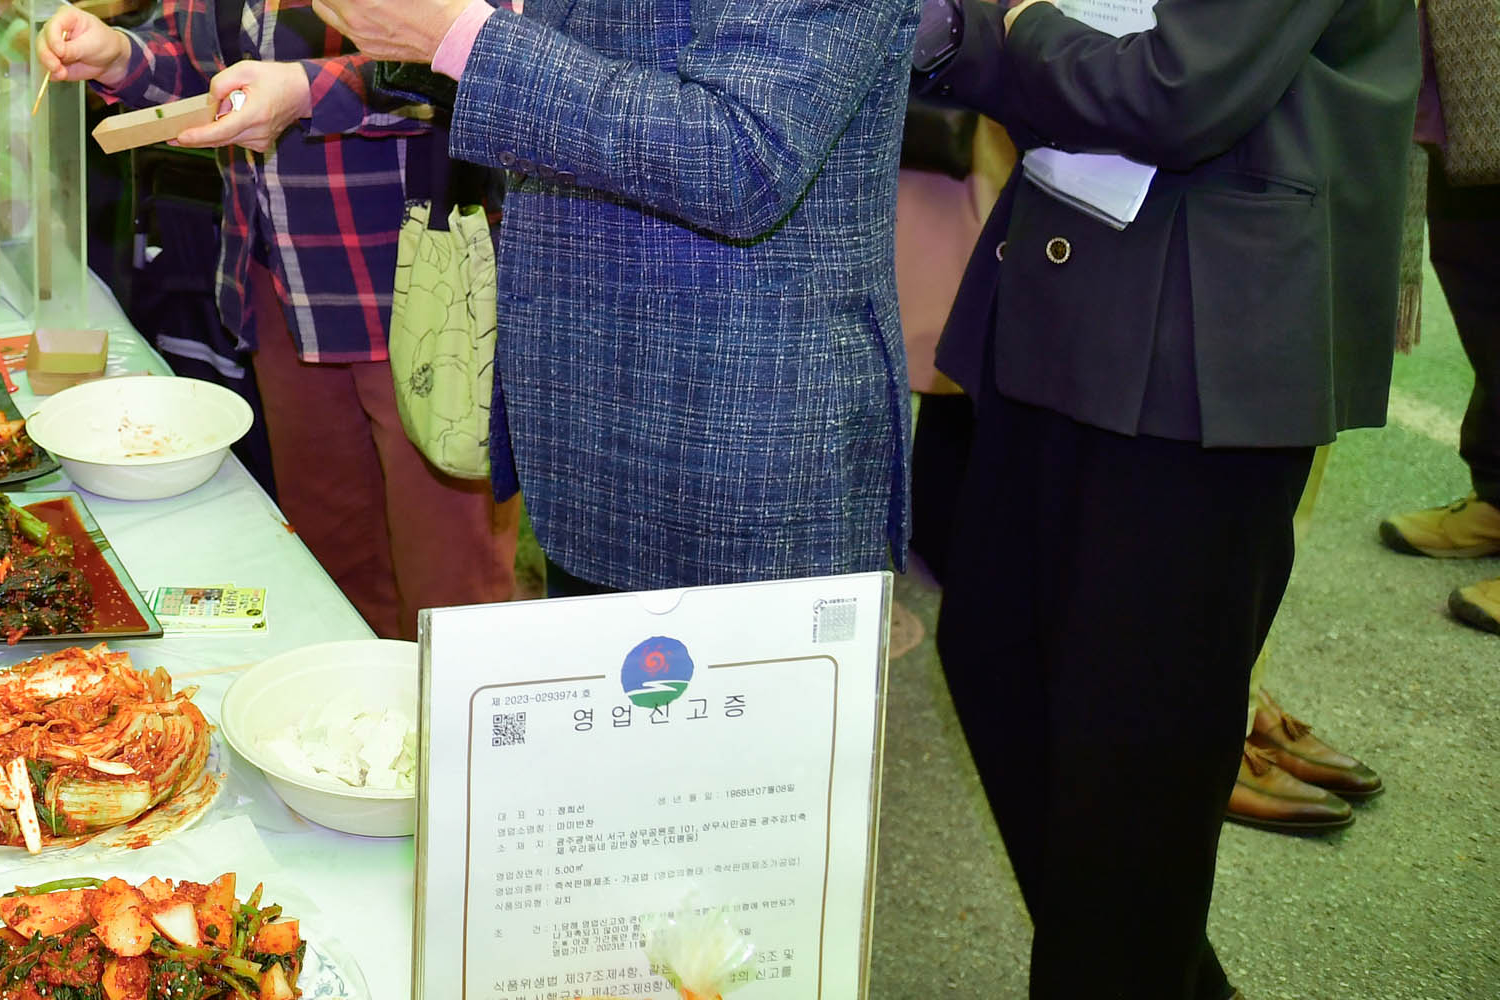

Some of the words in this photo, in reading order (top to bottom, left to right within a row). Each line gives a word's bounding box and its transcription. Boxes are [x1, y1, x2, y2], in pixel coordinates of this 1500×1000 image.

[504, 692, 578, 706] 2023-0293974
[556, 832, 604, 848] 광주광역시
[607, 830, 626, 842] 서구
[554, 895, 572, 906] 김치
[493, 975, 559, 993] 식품위생법
[783, 948, 795, 961] 및
